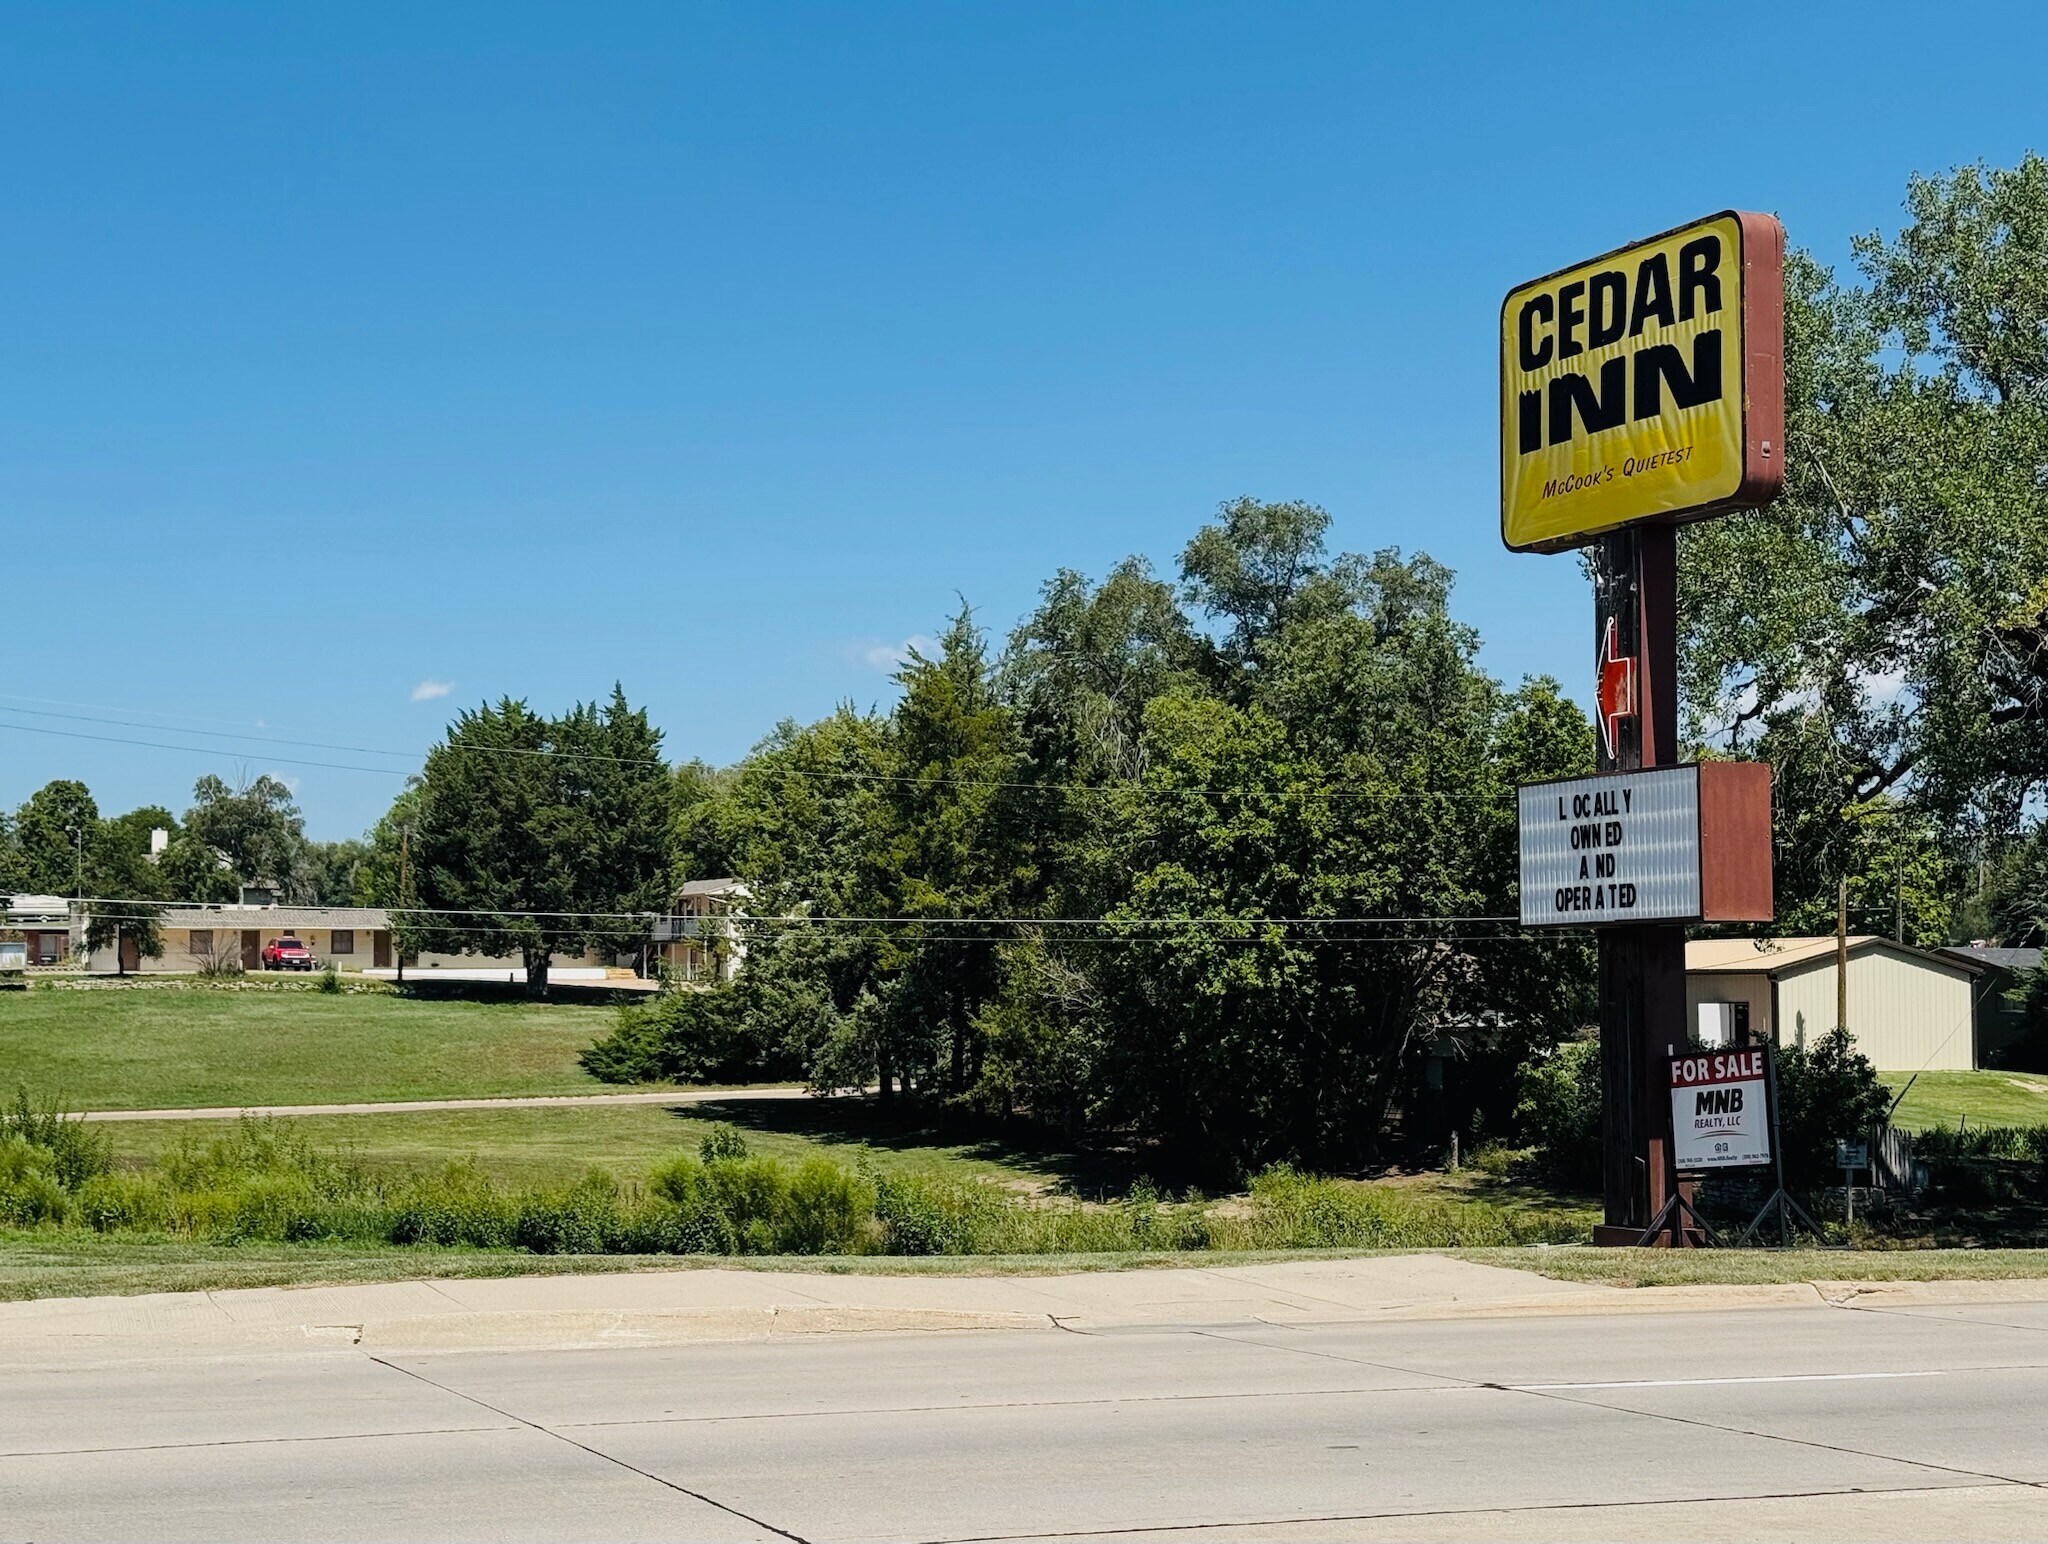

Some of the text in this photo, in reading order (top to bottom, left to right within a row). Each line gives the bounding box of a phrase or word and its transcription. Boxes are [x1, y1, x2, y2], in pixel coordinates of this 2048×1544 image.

[1519, 235, 1723, 372] CEDAR
[1519, 329, 1723, 456] INN
[1623, 446, 1694, 476] QUIETEST
[1558, 789, 1632, 820] LOCALLY
[1570, 821, 1623, 850] OWNED
[1579, 853, 1616, 880] AND
[1555, 883, 1637, 912] OPERATED
[1671, 1052, 1763, 1083] FOR SALE
[1695, 1088, 1744, 1116] MNB
[1694, 1115, 1741, 1129] REALTY, LLC
